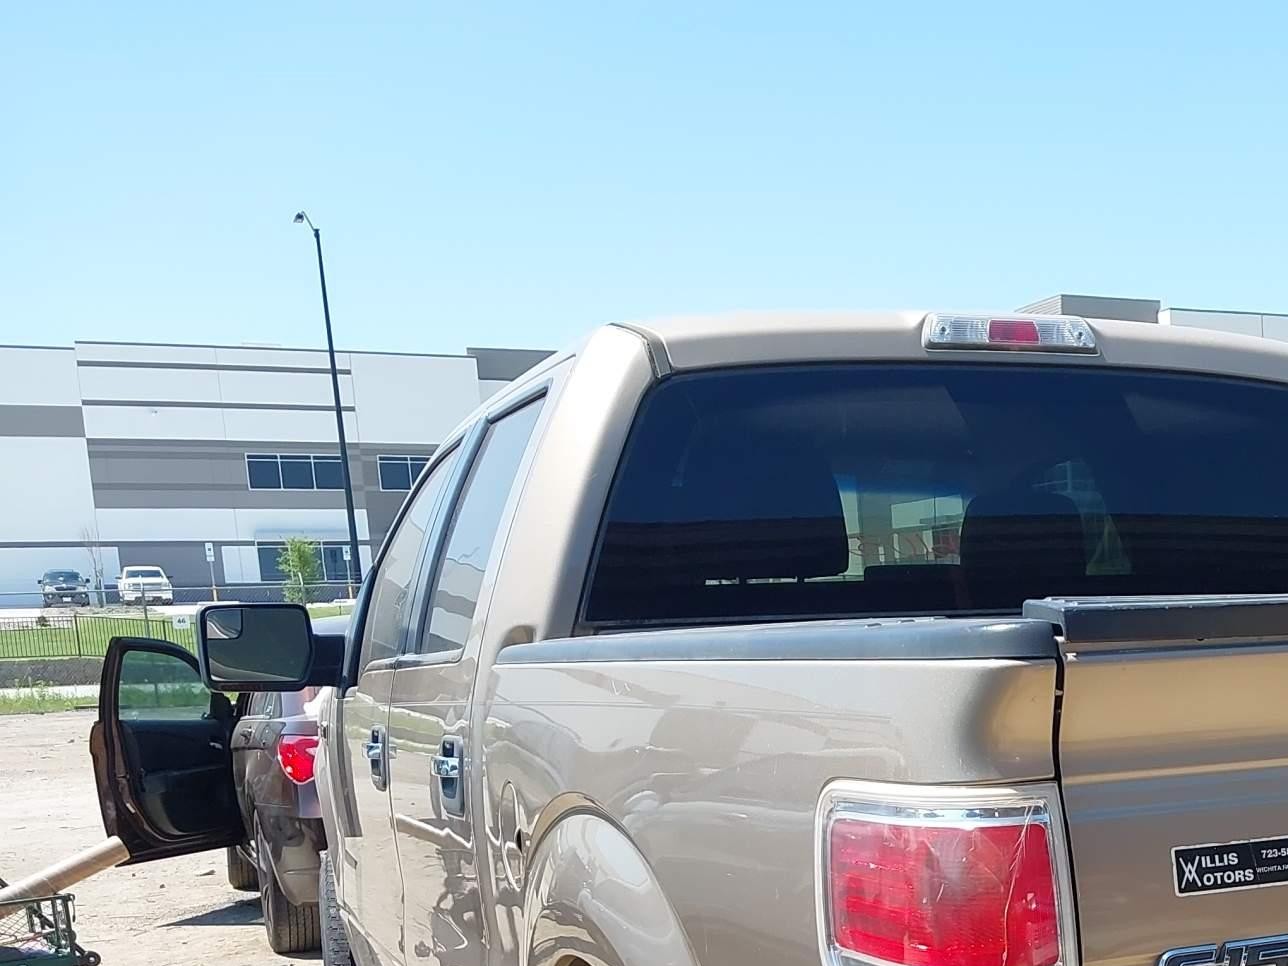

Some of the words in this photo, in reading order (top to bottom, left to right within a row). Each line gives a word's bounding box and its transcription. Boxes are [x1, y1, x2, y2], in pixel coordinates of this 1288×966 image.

[1179, 852, 1238, 880] WILLIS
[1180, 861, 1254, 889] MOTORS
[1256, 864, 1281, 873] WICHITA
